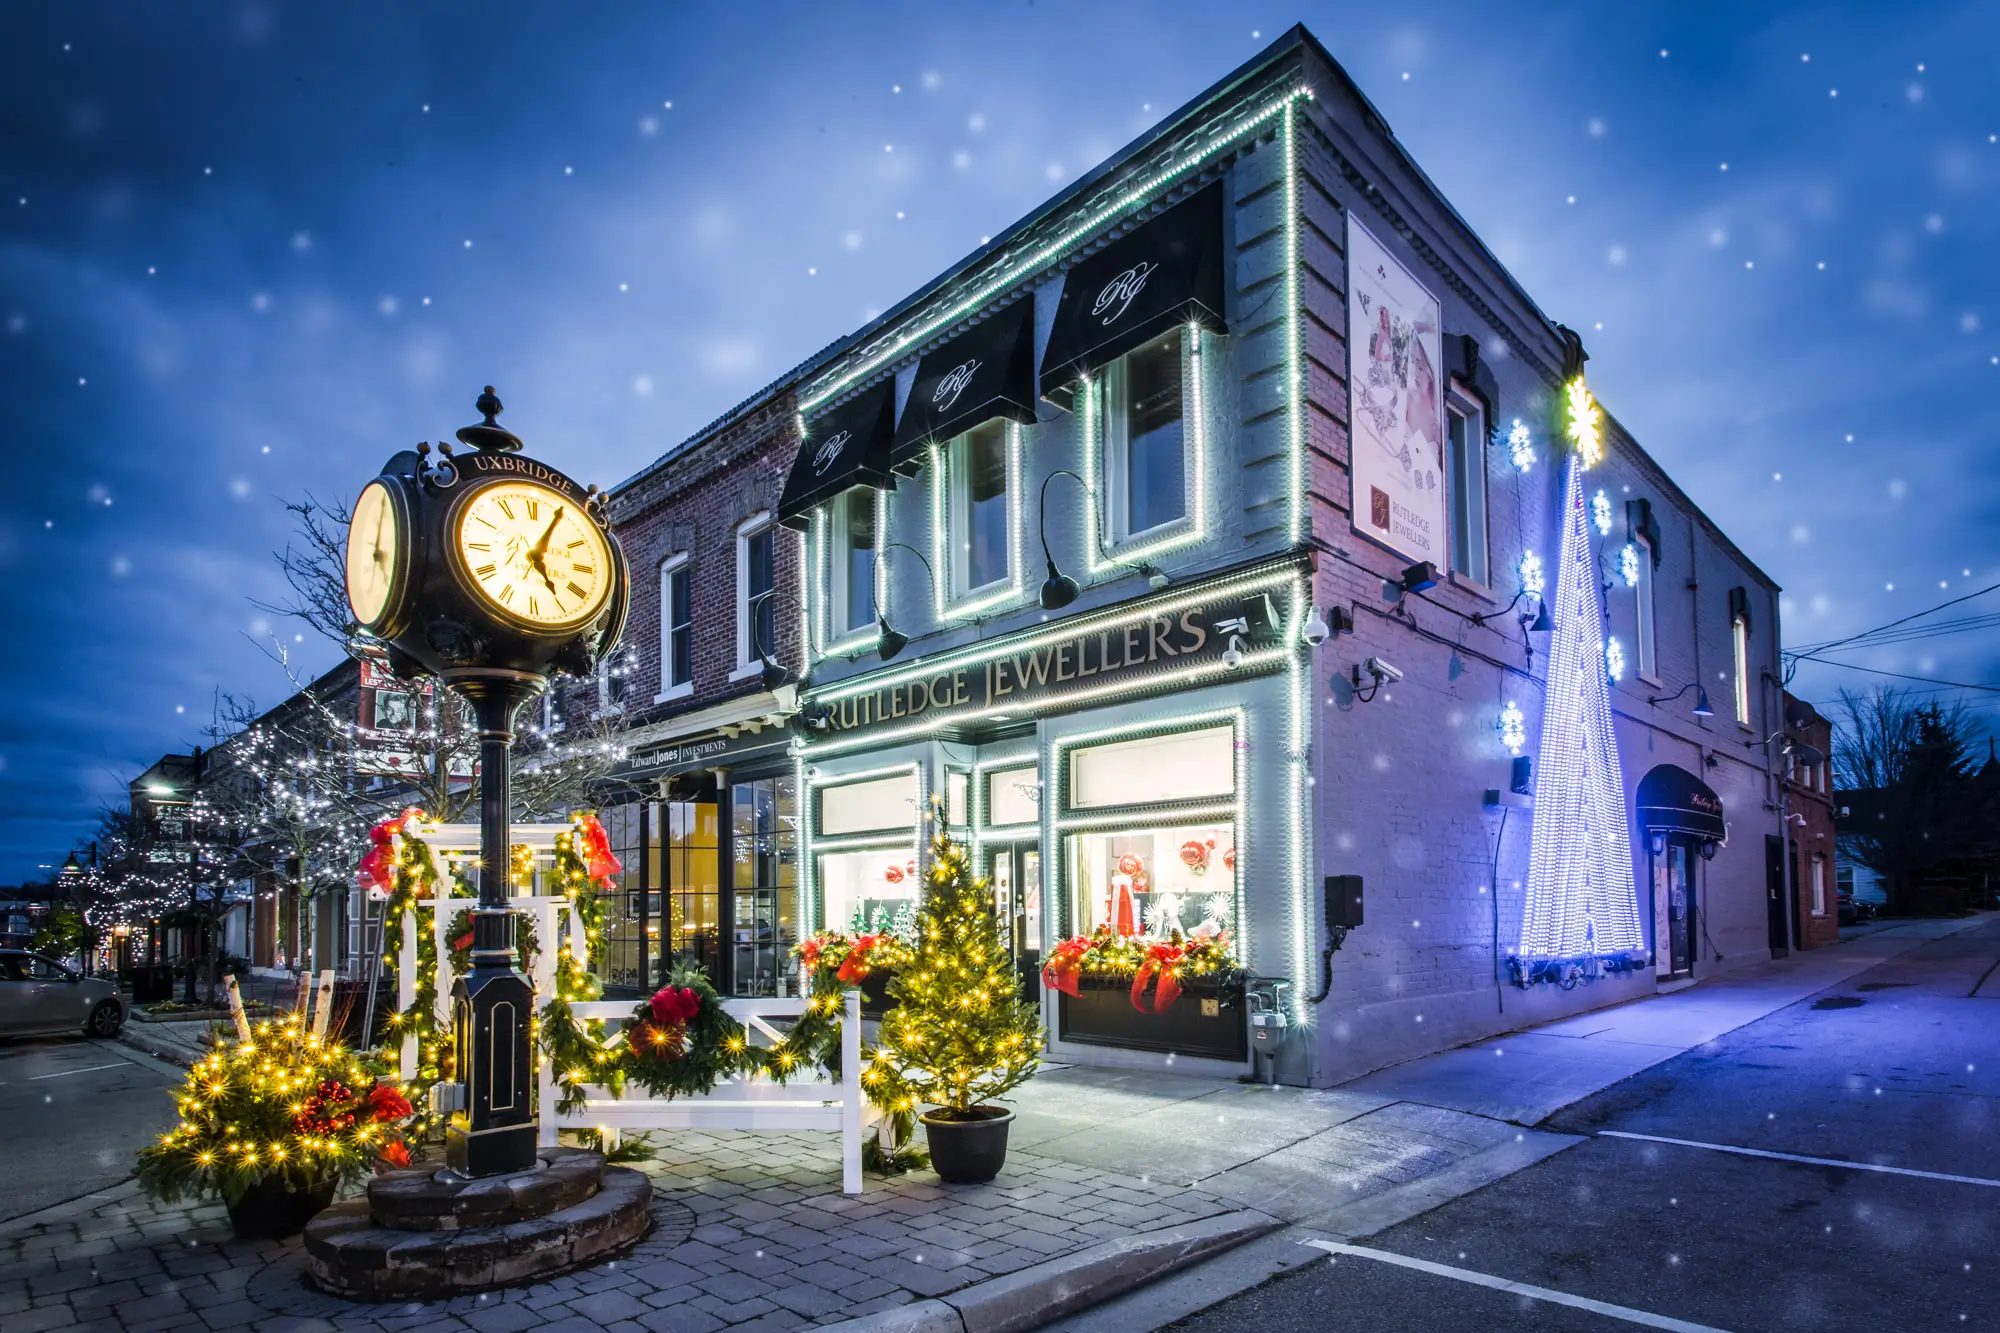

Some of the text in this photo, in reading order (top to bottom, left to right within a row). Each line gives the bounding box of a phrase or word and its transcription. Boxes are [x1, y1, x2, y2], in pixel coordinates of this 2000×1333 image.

[473, 456, 574, 495] UXBRIDGE
[1392, 501, 1430, 534] RUTLEDGE
[1392, 519, 1430, 551] JEWELLERS
[826, 609, 1207, 732] RUTLEDGE JEWELLERS
[682, 740, 726, 758] INVESTMENTS
